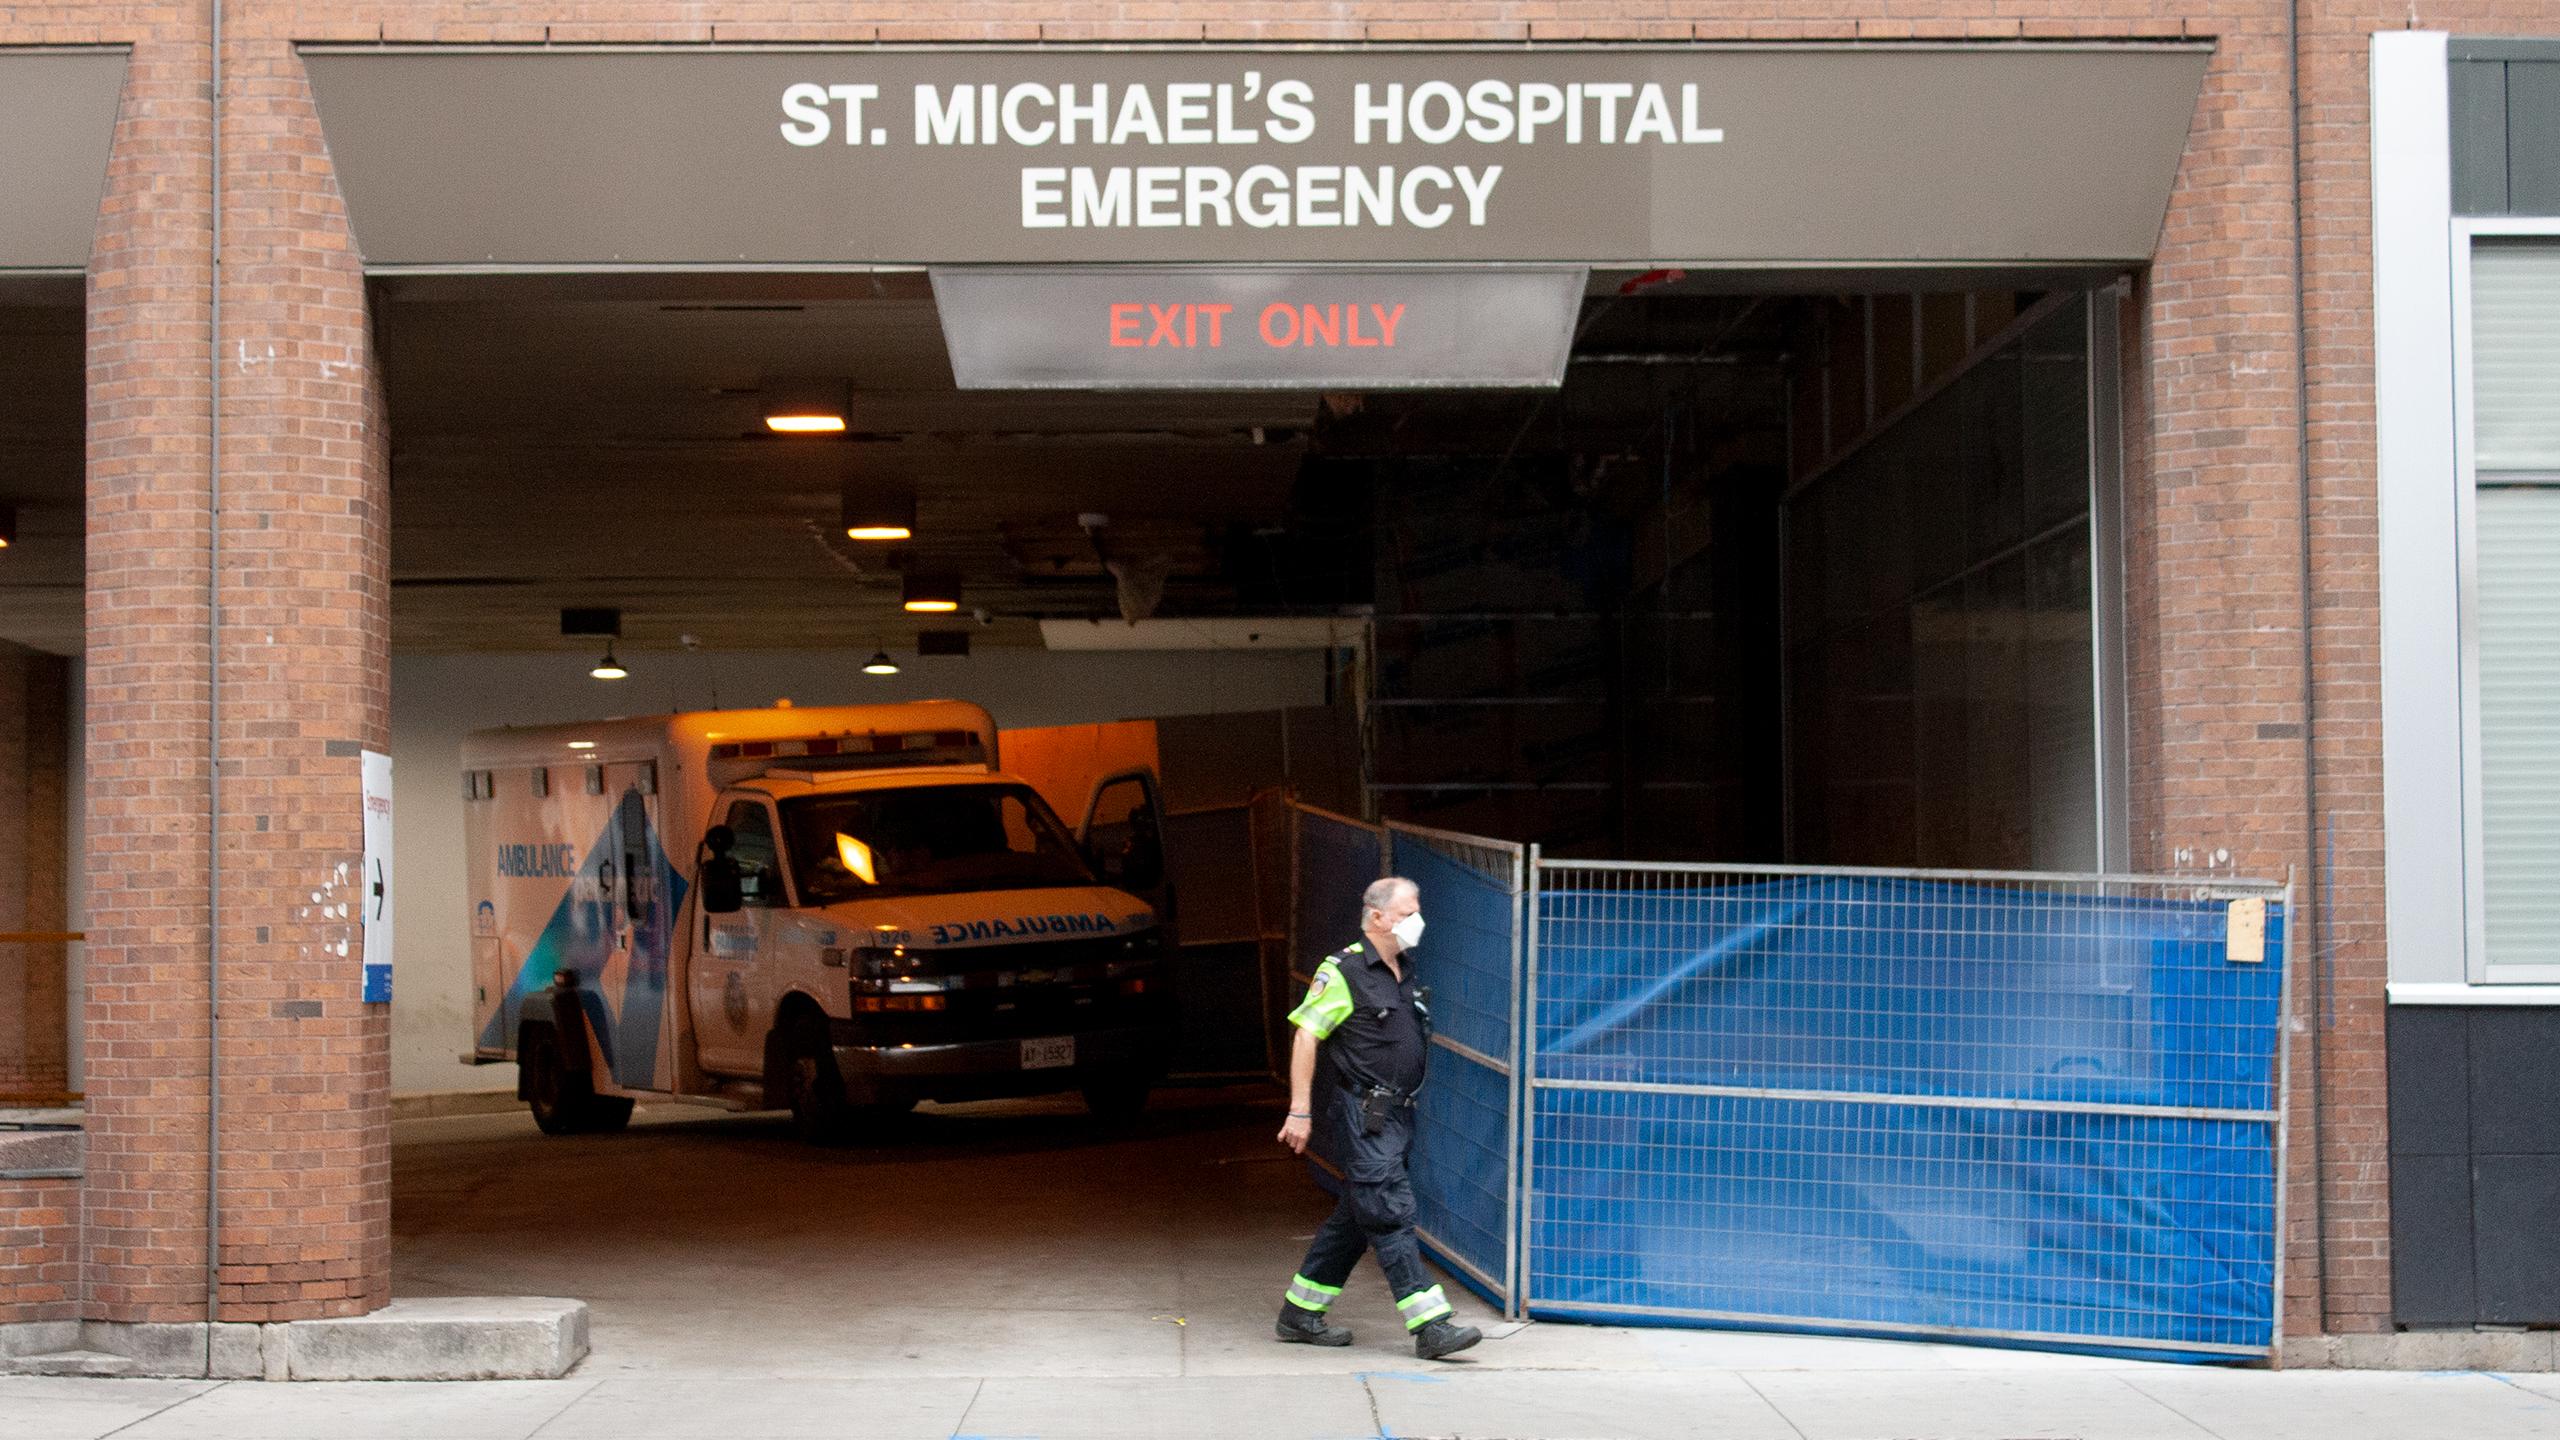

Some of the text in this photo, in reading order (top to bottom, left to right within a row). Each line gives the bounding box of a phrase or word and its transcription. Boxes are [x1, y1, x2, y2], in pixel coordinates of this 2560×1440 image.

[780, 71, 1724, 147] ST. MICHAEL'S HOSPITAL
[1021, 164, 1502, 229] EMERGENCY
[1109, 302, 1406, 348] EXIT ONLY
[497, 844, 576, 877] AMBULANCE
